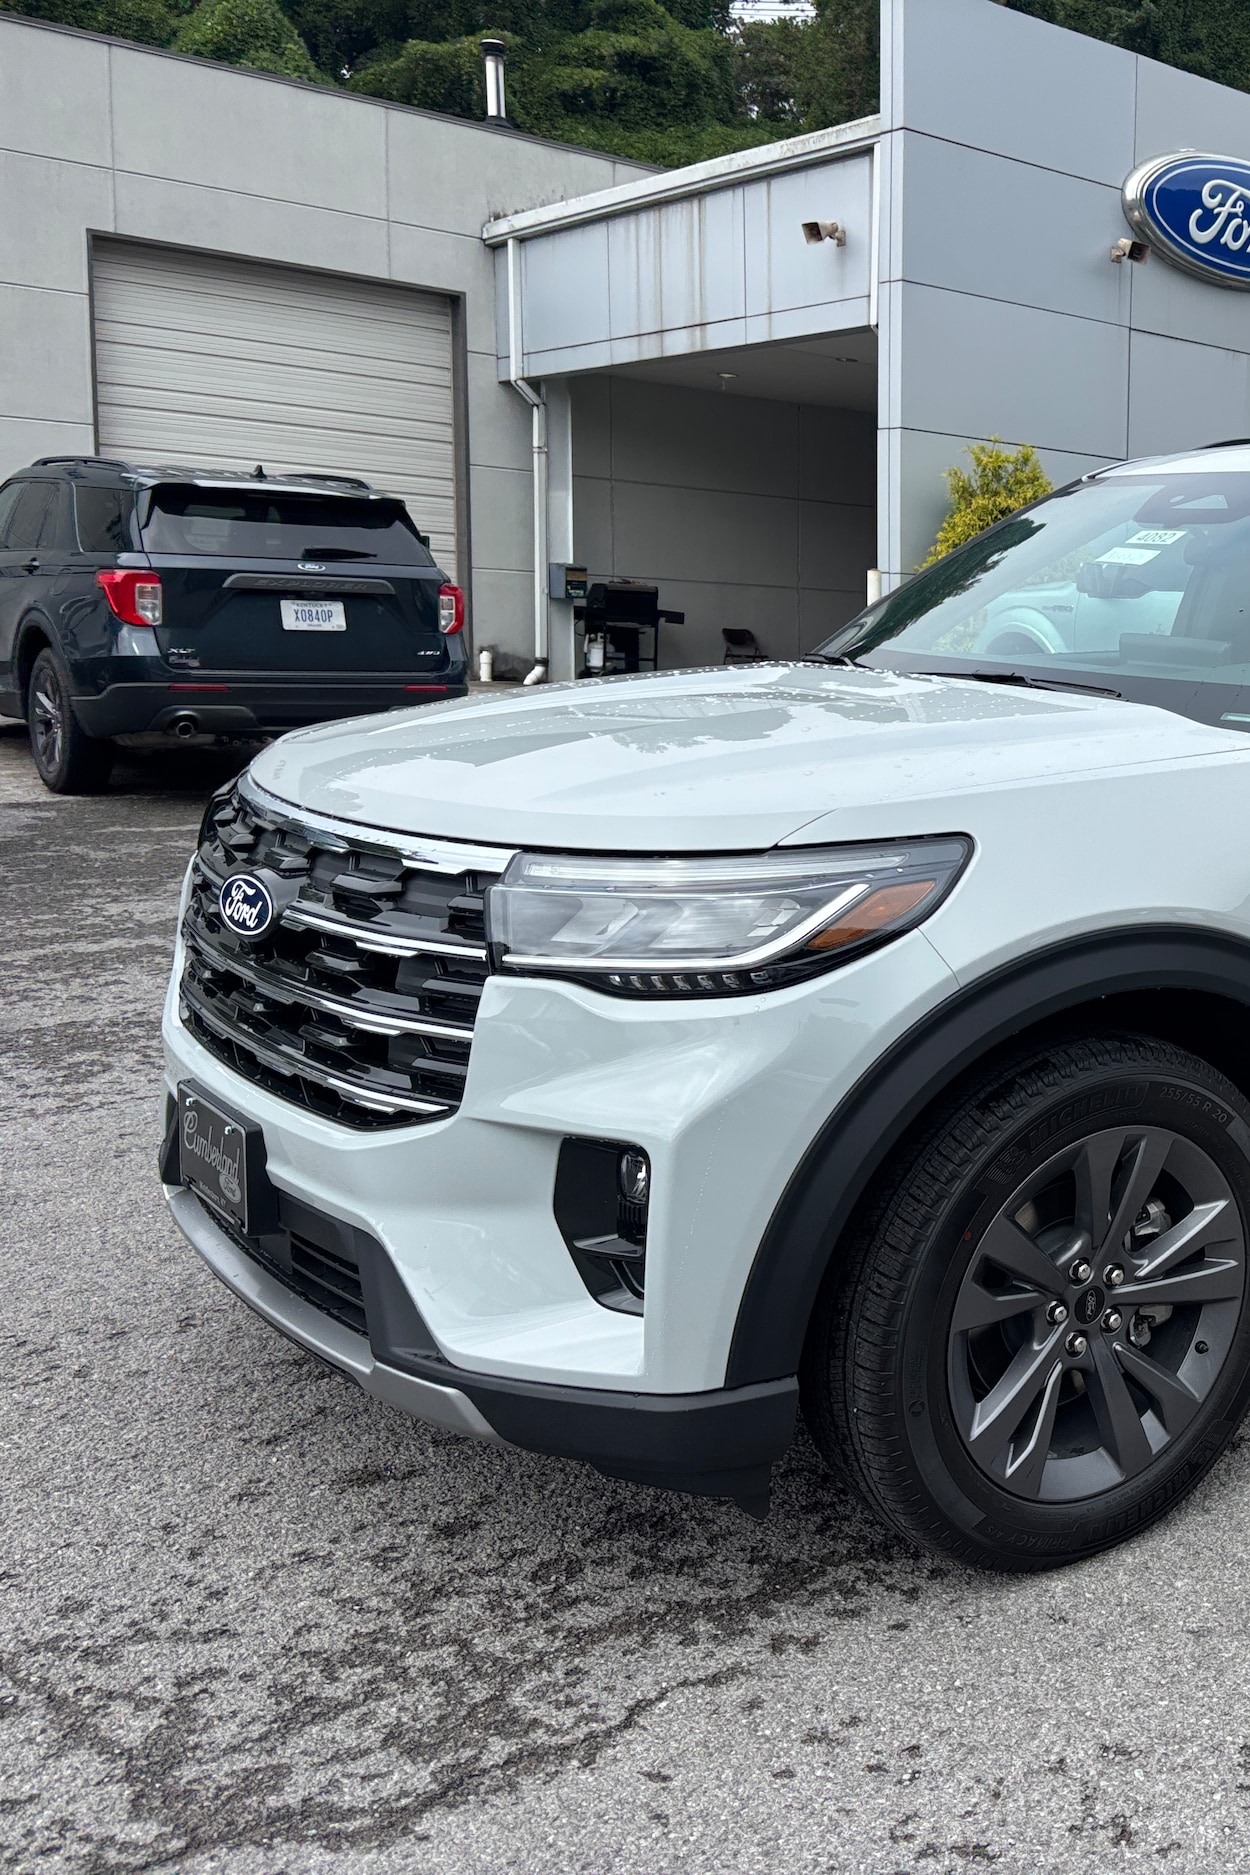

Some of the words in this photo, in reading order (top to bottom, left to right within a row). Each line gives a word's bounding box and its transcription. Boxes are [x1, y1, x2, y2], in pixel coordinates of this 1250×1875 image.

[1136, 532, 1177, 543] 4082
[254, 579, 368, 591] EXPLORER
[294, 609, 333, 623] X0840P
[225, 880, 262, 928] Ford
[1028, 1087, 1141, 1151] MICHELIN
[1159, 1087, 1202, 1107] 255/55
[1202, 1101, 1212, 1113] R
[1211, 1108, 1228, 1123] 20
[183, 1111, 240, 1184] Cumberland
[1087, 1462, 1192, 1541] MICHELIN
[1006, 1532, 1071, 1549] PRIMACY
